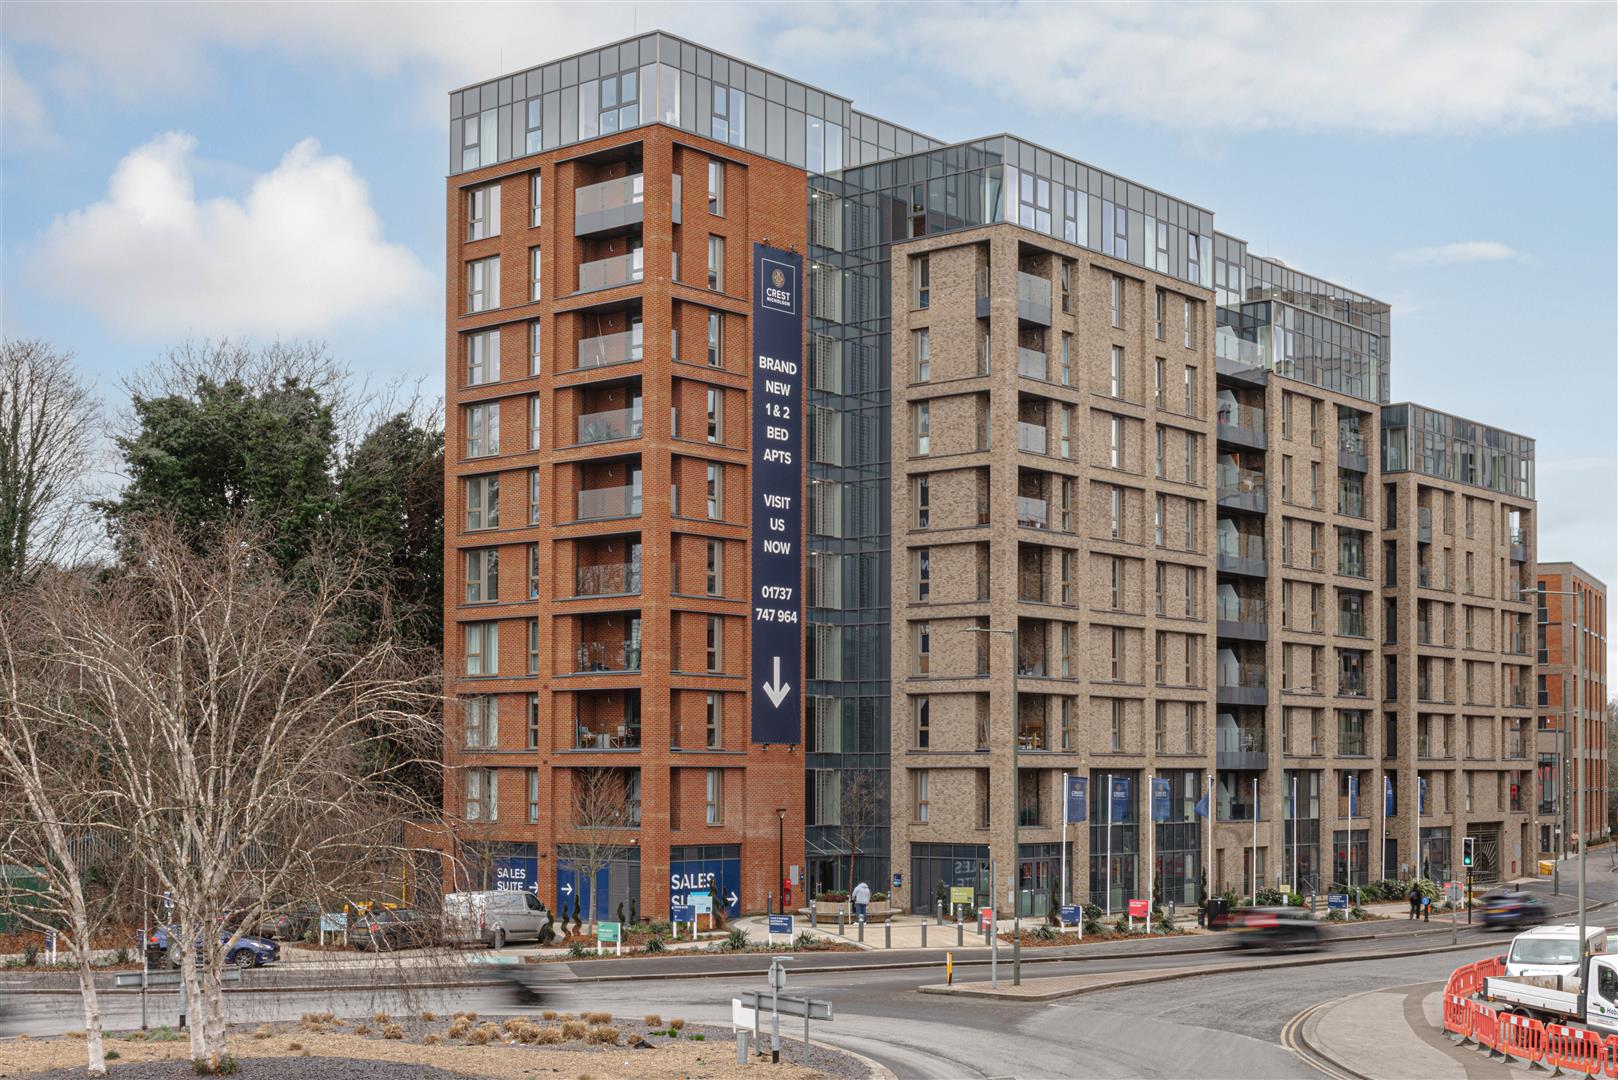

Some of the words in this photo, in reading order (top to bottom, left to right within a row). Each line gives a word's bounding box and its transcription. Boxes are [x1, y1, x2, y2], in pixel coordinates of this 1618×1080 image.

[766, 287, 791, 301] CREST
[759, 356, 797, 375] BRAND
[765, 380, 790, 397] NEW
[767, 426, 789, 441] BED
[763, 448, 792, 465] APTS
[764, 494, 791, 510] VISIT
[770, 517, 785, 532] US
[764, 540, 791, 555] NOW
[761, 585, 793, 600] 01737
[755, 608, 775, 622] 747
[777, 609, 798, 624] 964
[497, 867, 526, 879] SALES
[671, 872, 715, 890] SALES
